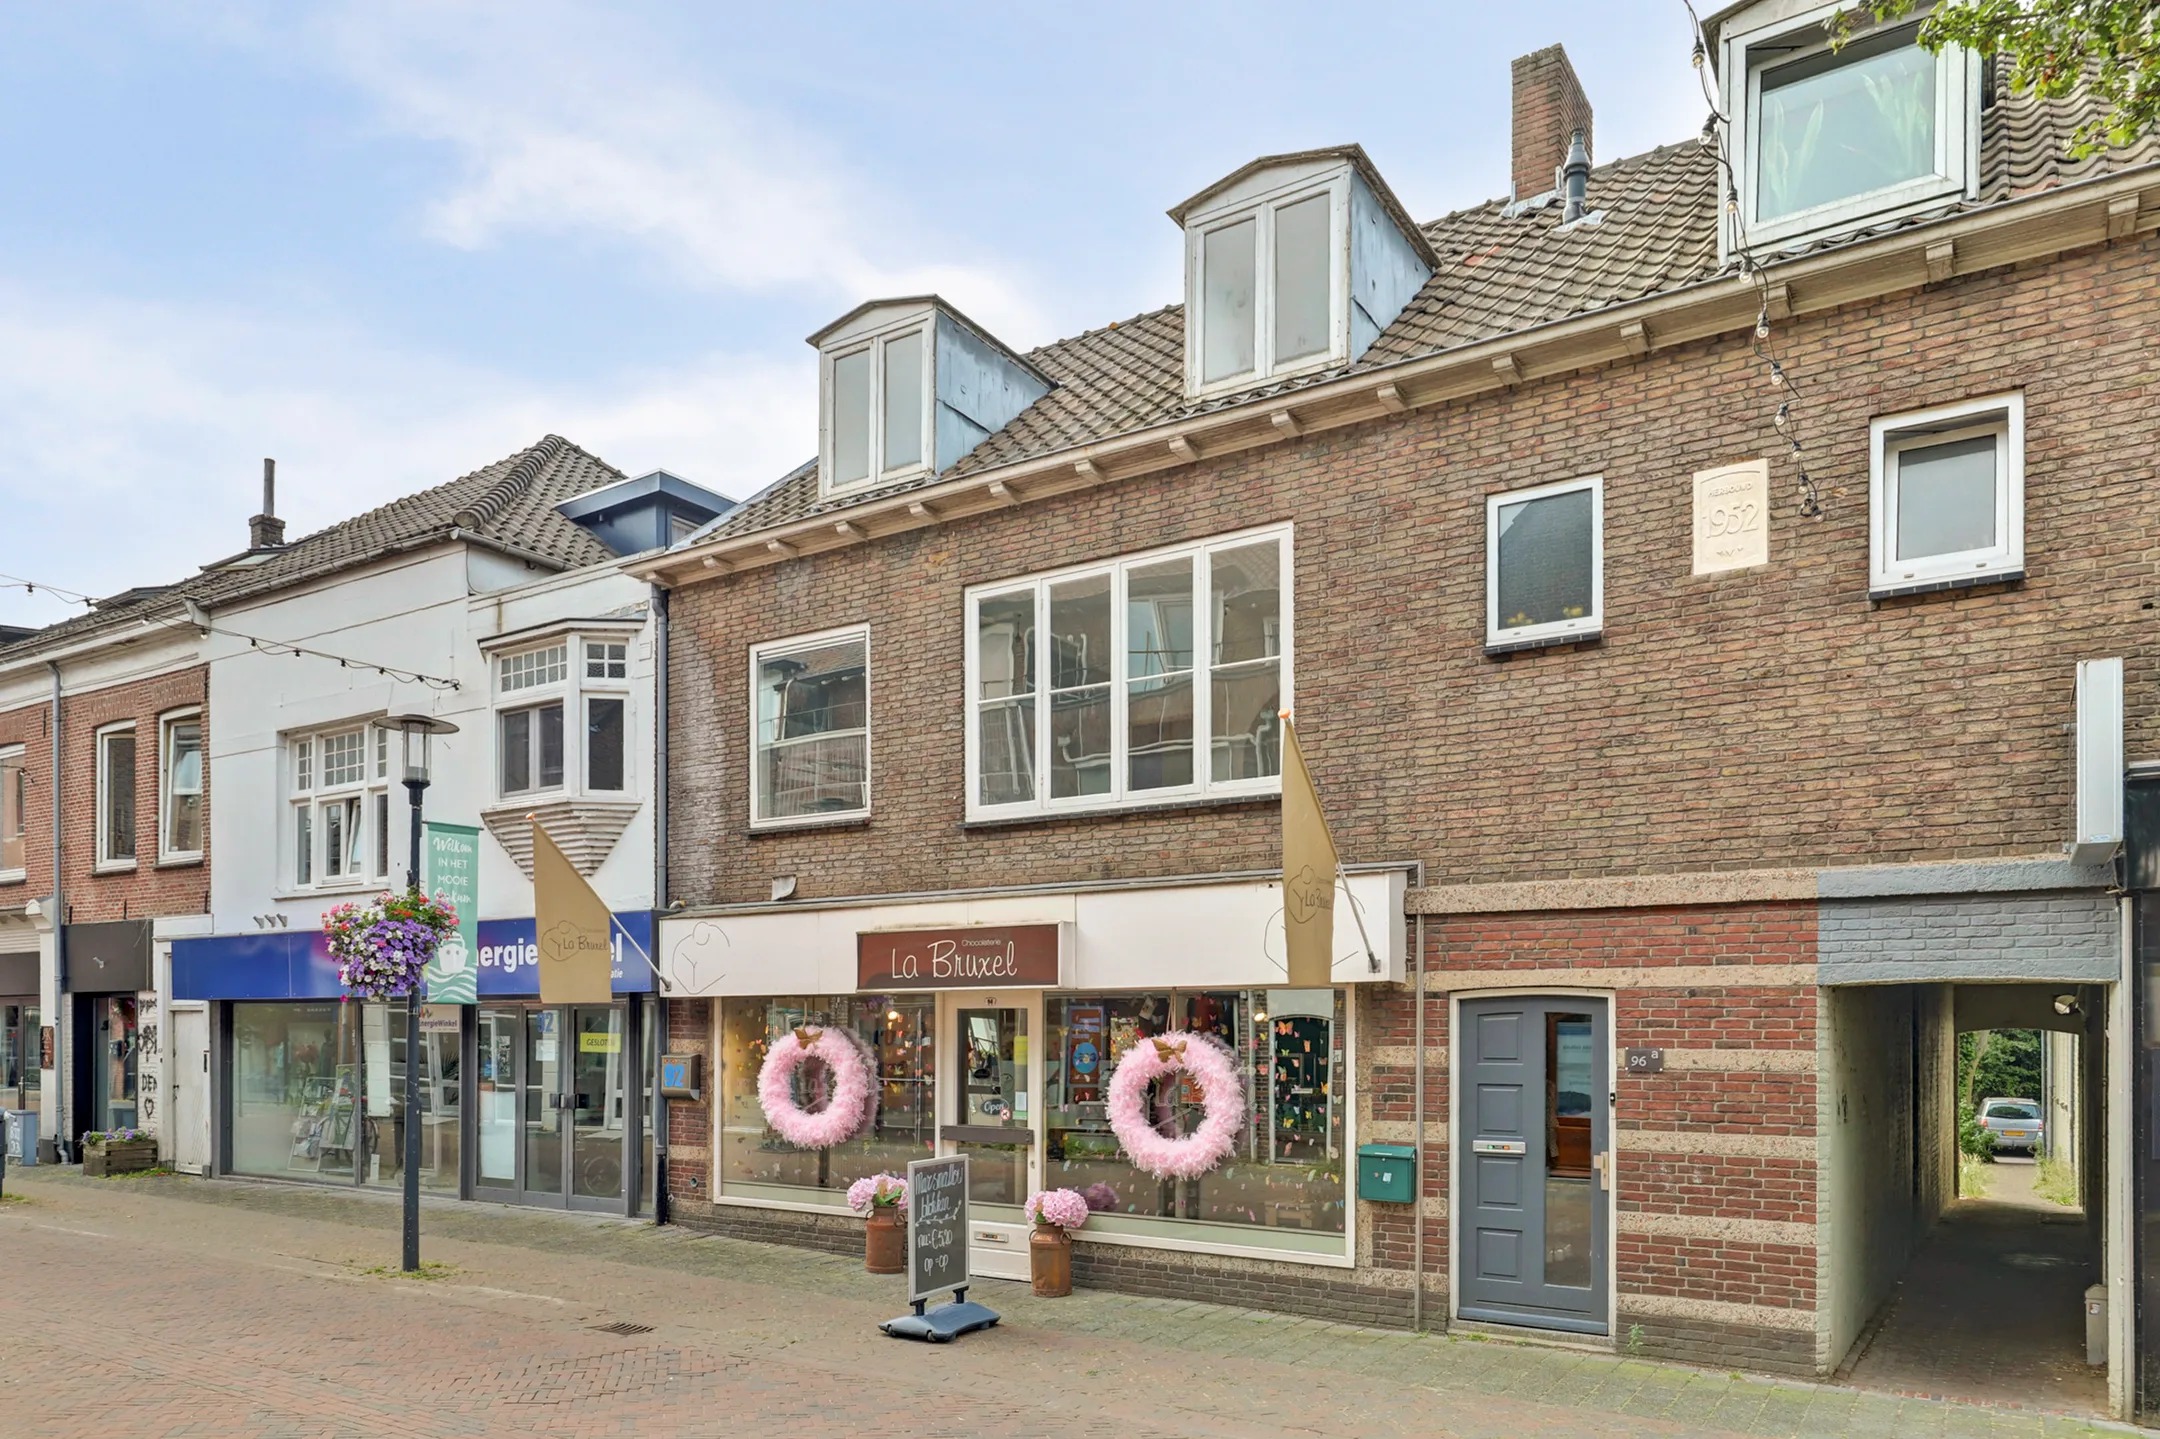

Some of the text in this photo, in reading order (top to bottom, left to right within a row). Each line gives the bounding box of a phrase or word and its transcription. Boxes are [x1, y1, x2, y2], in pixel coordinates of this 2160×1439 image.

[1702, 502, 1760, 539] 1952
[433, 837, 472, 853] Welkom
[438, 857, 468, 869] IN HET
[437, 874, 468, 885] MOOIE
[563, 939, 574, 950] La
[961, 938, 1002, 947] Chocolaterie
[477, 937, 539, 972] ergie
[892, 939, 1018, 979] La Bruxel
[536, 1012, 554, 1033] 92
[586, 1038, 615, 1047] GESLOTN
[1630, 1055, 1647, 1067] 96
[1651, 1050, 1659, 1059] a
[664, 1063, 685, 1088] 92
[983, 1100, 1004, 1114] Open
